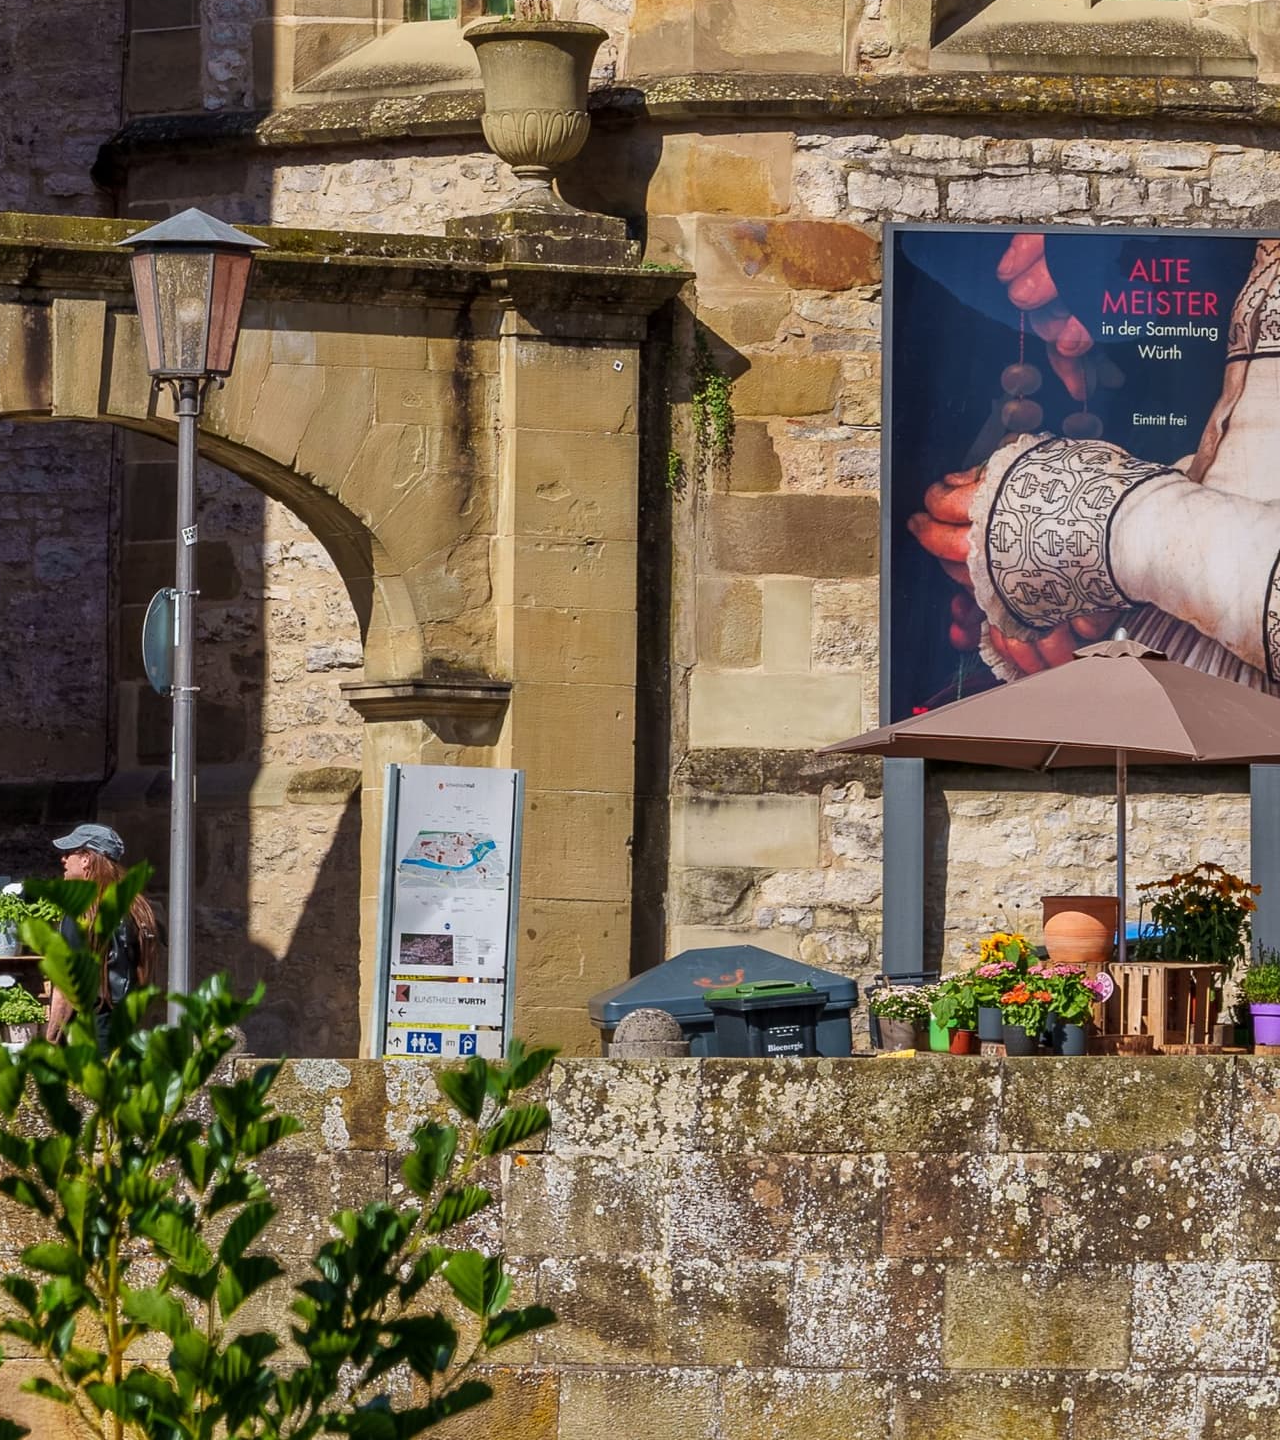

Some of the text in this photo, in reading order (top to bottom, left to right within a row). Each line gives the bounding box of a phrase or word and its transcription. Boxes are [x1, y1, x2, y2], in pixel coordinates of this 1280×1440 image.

[1129, 258, 1191, 283] ALTE
[1102, 290, 1218, 316] MEISTER
[1102, 320, 1218, 341] in der Sammlung
[1138, 344, 1182, 360] Würth
[1133, 412, 1187, 426] Eintritt frei
